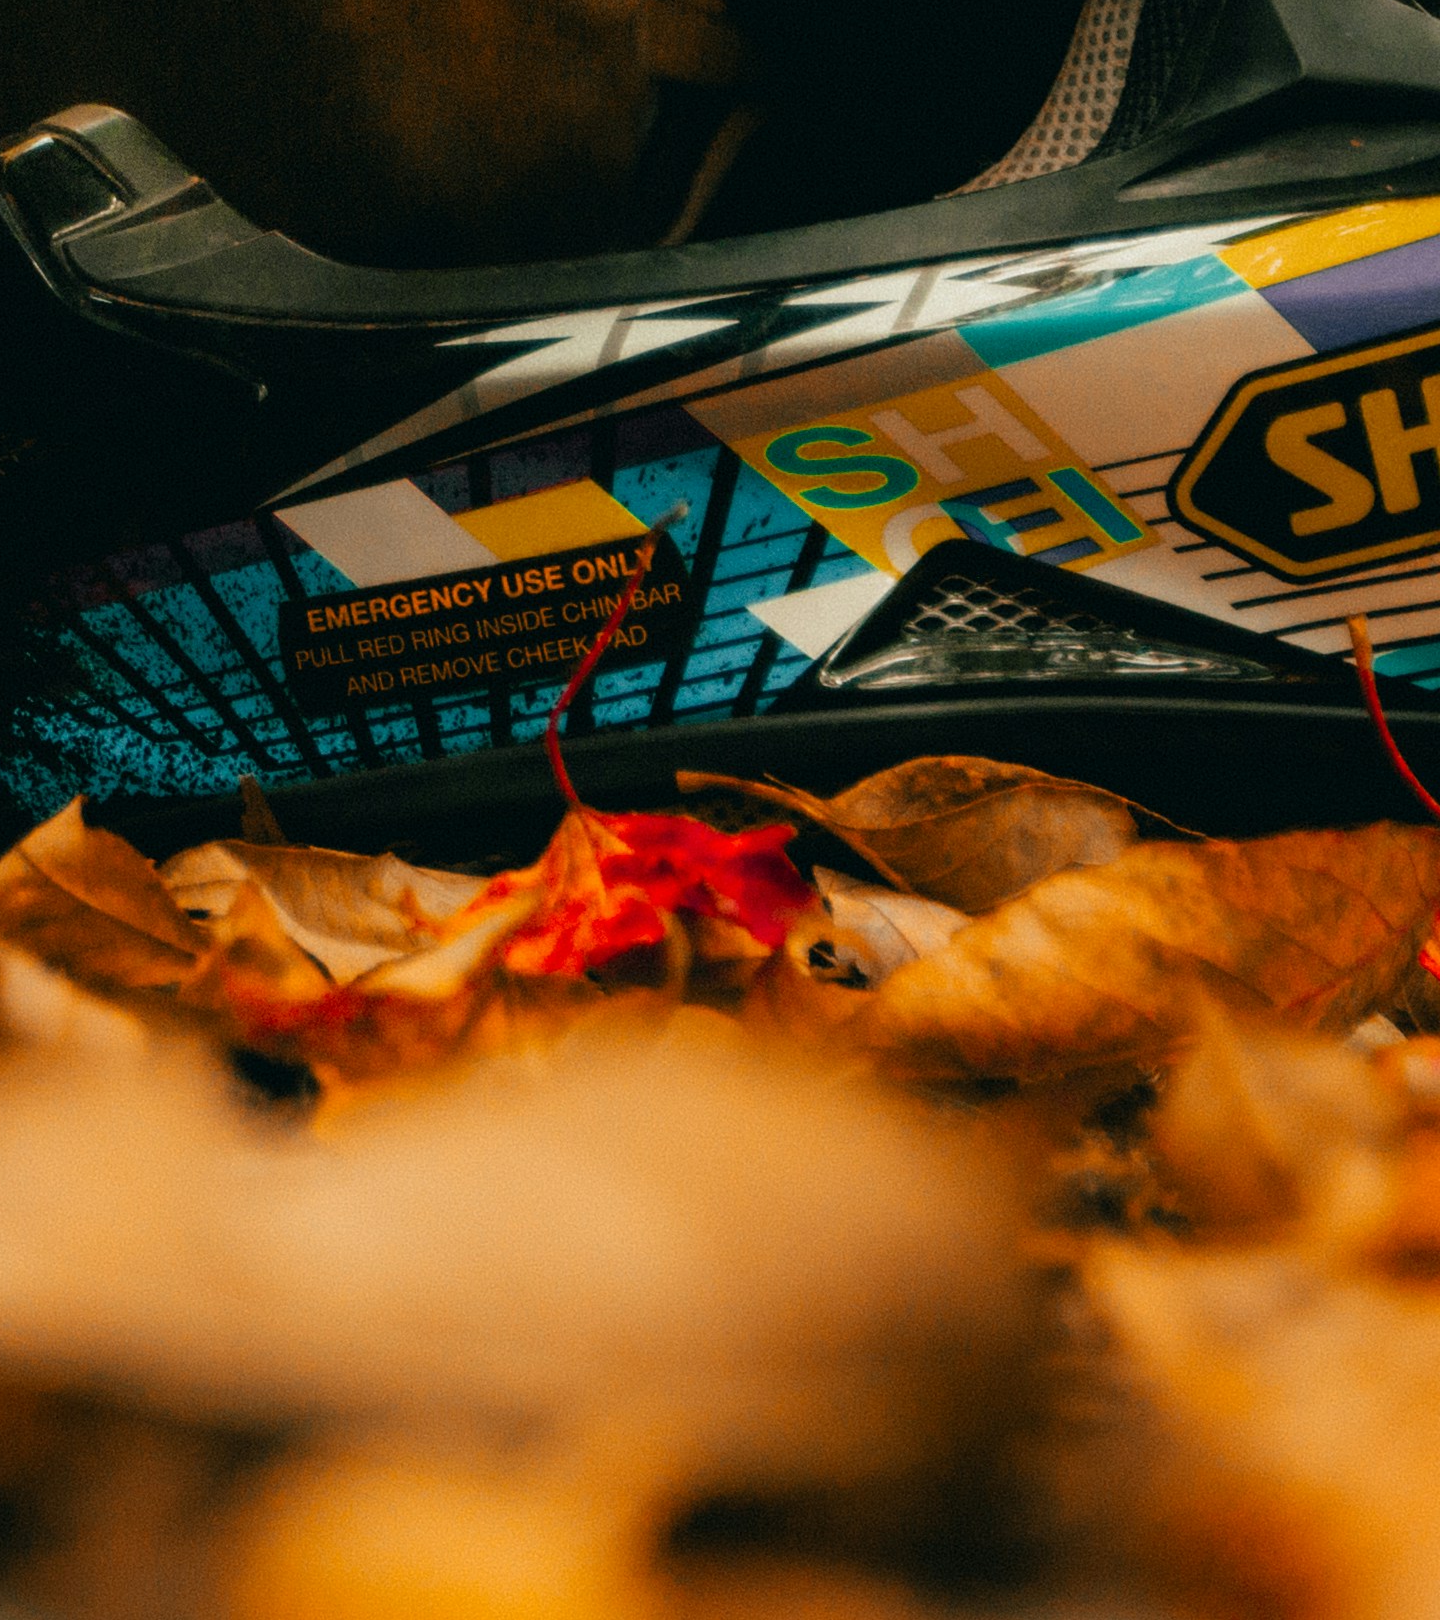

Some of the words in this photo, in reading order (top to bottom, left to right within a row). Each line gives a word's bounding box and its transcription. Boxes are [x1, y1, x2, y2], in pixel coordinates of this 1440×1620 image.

[295, 642, 355, 671] PULL
[358, 634, 406, 662] RED
[412, 623, 470, 652] RING
[477, 606, 557, 641] INSIDE
[562, 593, 622, 623] CHIN
[630, 583, 681, 611] BAR
[307, 577, 495, 634] EMERGENCY
[502, 564, 565, 599] USE
[572, 547, 656, 585] ONLY
[347, 666, 395, 697] AND
[399, 651, 499, 687] REMOVE
[507, 635, 591, 670] CHEEK
